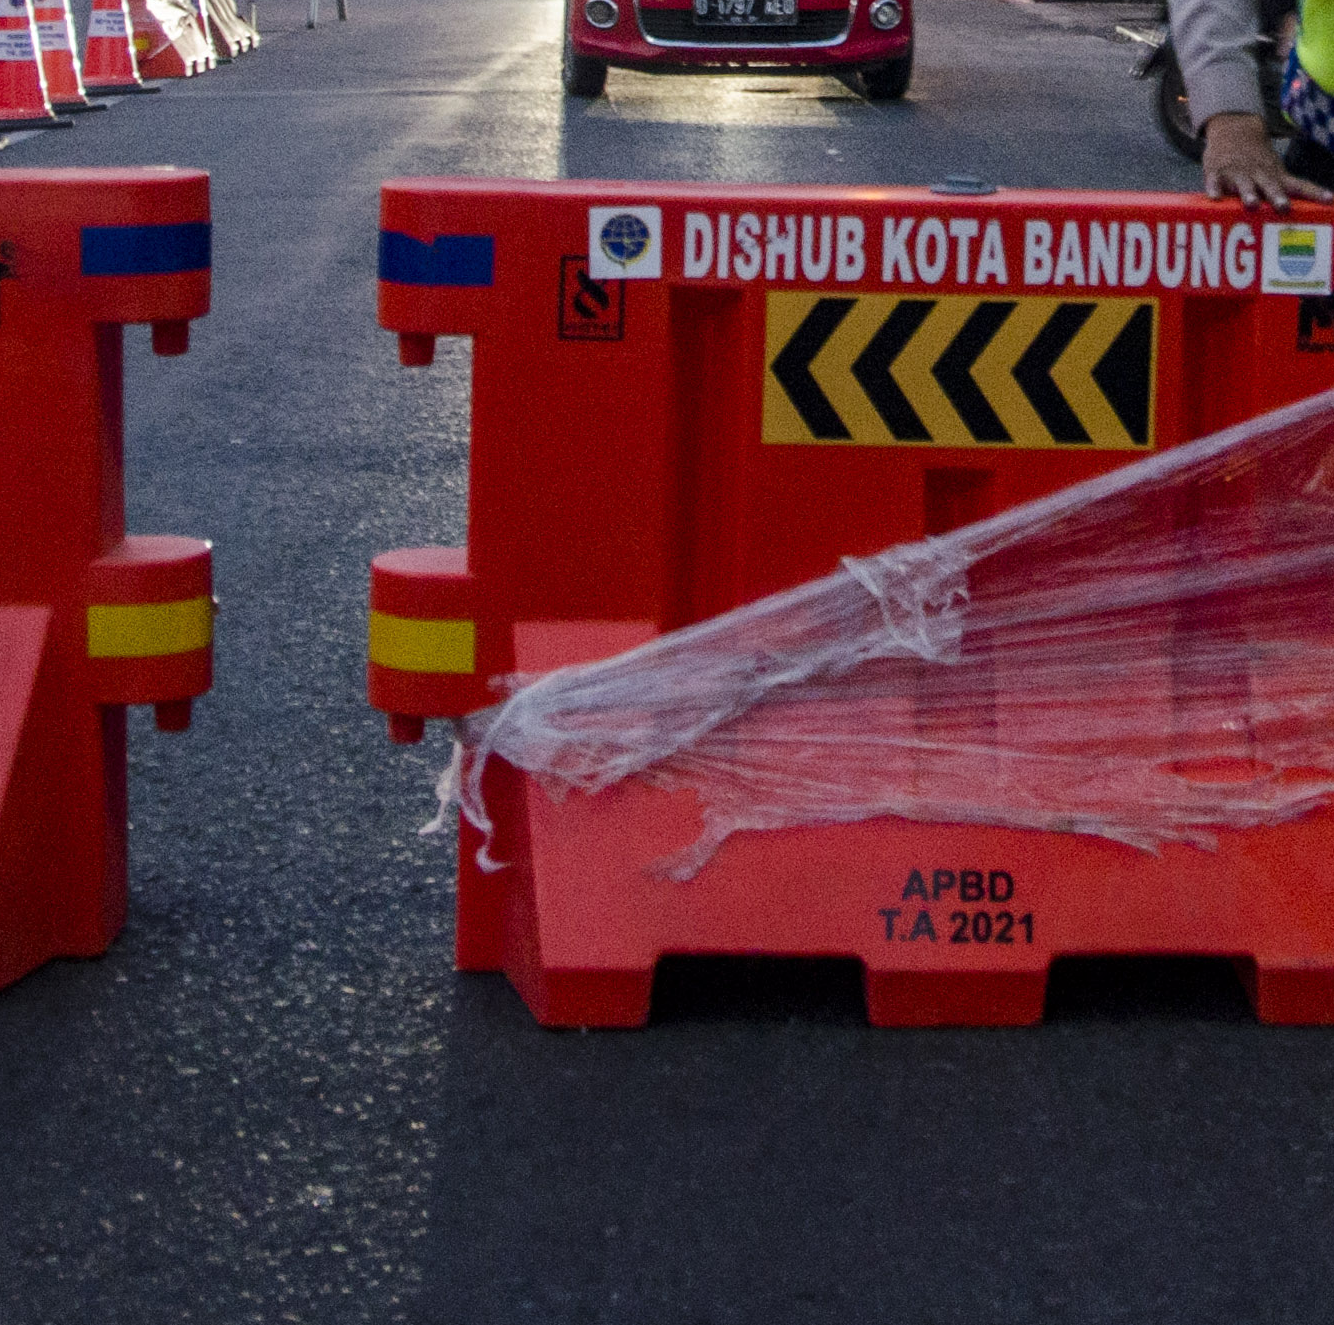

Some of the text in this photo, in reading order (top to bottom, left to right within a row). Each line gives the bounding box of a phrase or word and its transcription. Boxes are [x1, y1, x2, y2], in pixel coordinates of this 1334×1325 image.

[683, 211, 1257, 290] DISHUB KOTA BANDUNG
[901, 869, 1015, 902] APBD
[950, 911, 1034, 944] 2021
